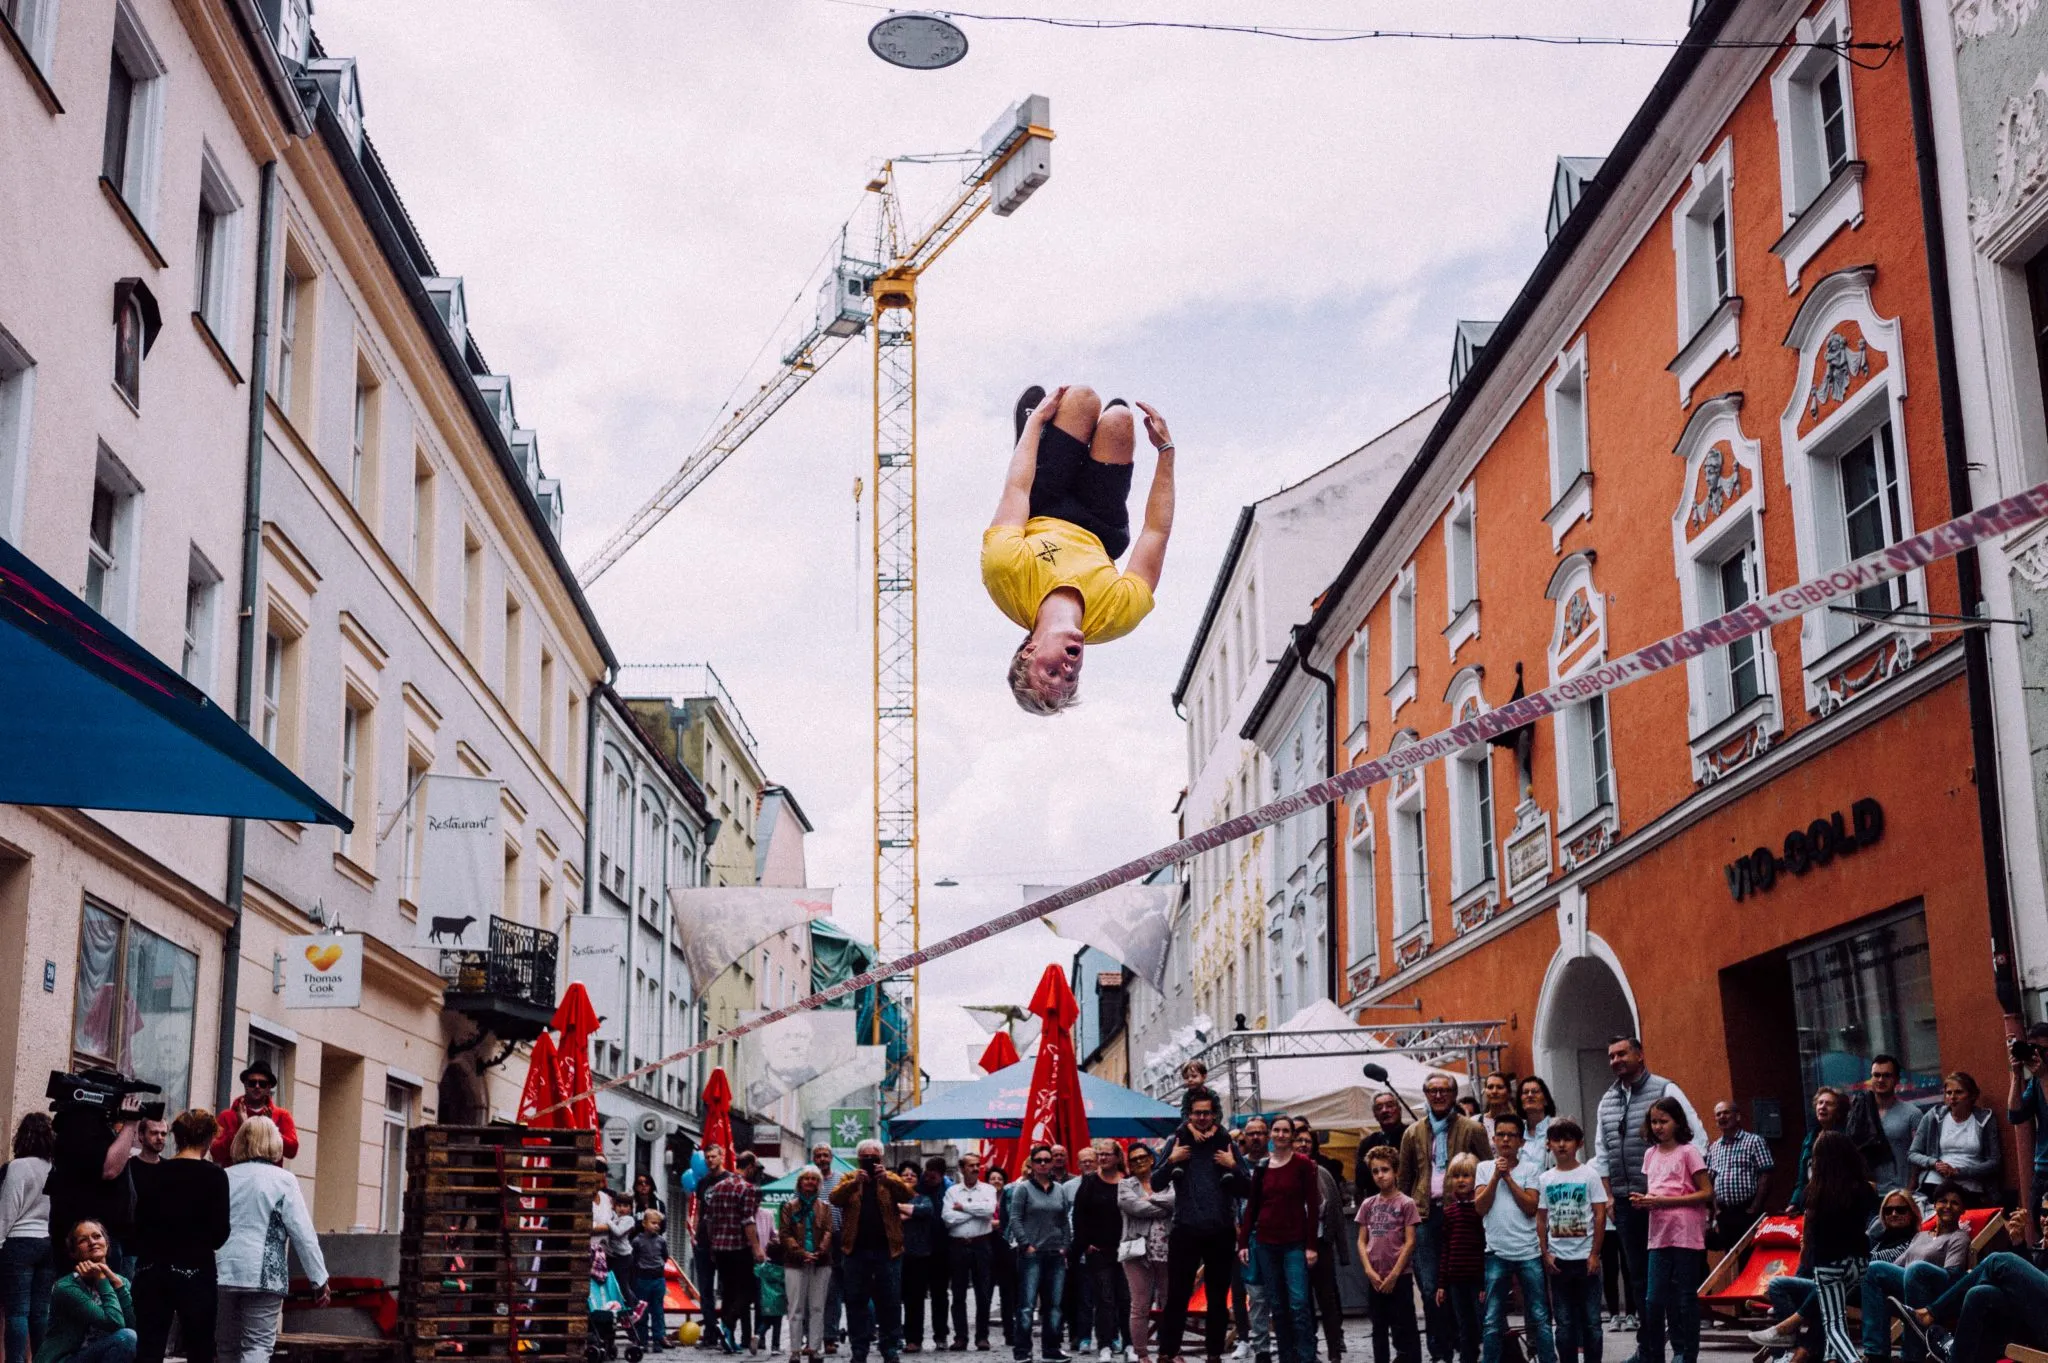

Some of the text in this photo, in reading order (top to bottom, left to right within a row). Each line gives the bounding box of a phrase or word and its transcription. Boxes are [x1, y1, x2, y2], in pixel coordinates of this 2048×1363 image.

[427, 815, 495, 831] Restaurant
[1724, 797, 1885, 902] VIO-GOLD
[304, 973, 343, 983] Thomas
[309, 984, 335, 993] Cook
